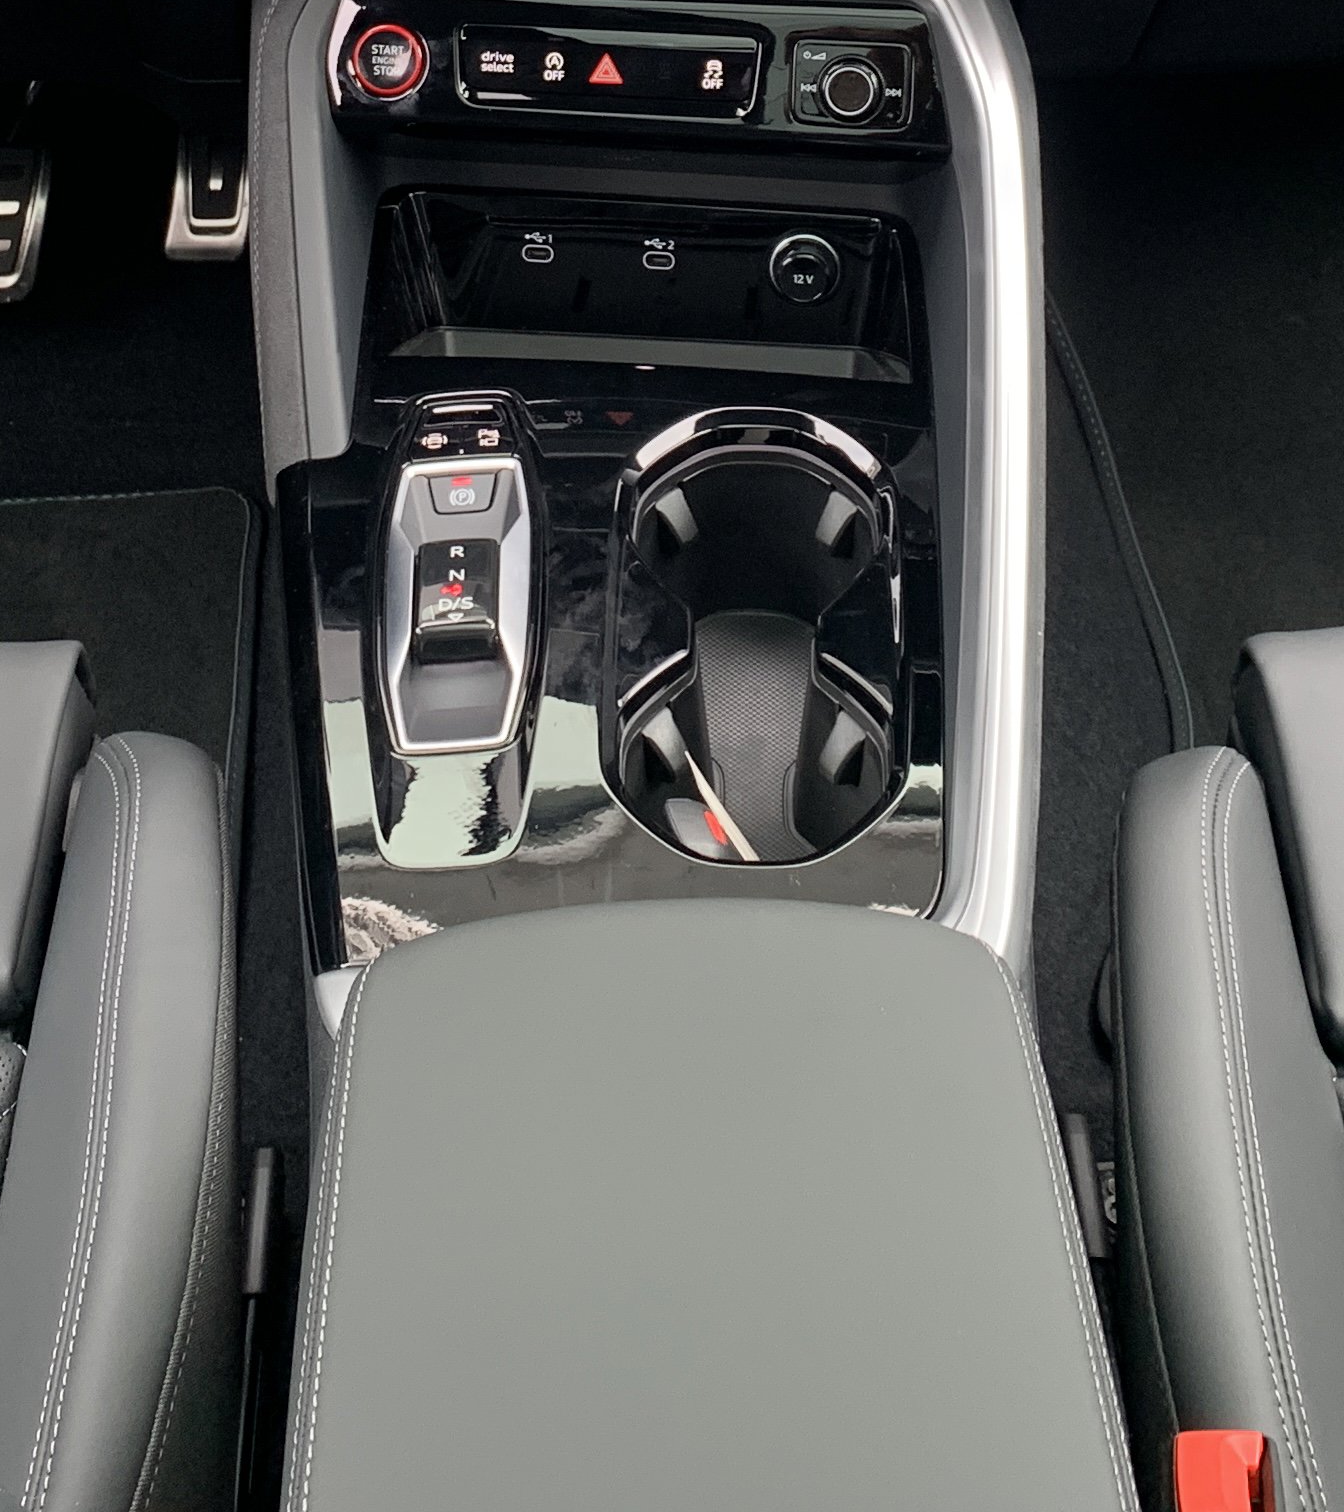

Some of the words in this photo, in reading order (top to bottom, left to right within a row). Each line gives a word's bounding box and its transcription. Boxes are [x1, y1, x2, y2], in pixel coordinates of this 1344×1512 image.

[371, 44, 405, 55] START
[481, 51, 515, 63] drive
[373, 65, 402, 76] STO
[481, 61, 515, 73] select
[543, 70, 565, 81] OFF
[701, 78, 724, 90] OFF
[547, 234, 553, 244] 1
[667, 239, 675, 251] 2
[792, 273, 803, 284] 12
[805, 273, 814, 285] V
[459, 492, 466, 502] P
[450, 546, 465, 558] R
[448, 568, 465, 582] N
[438, 597, 474, 612] D/S
